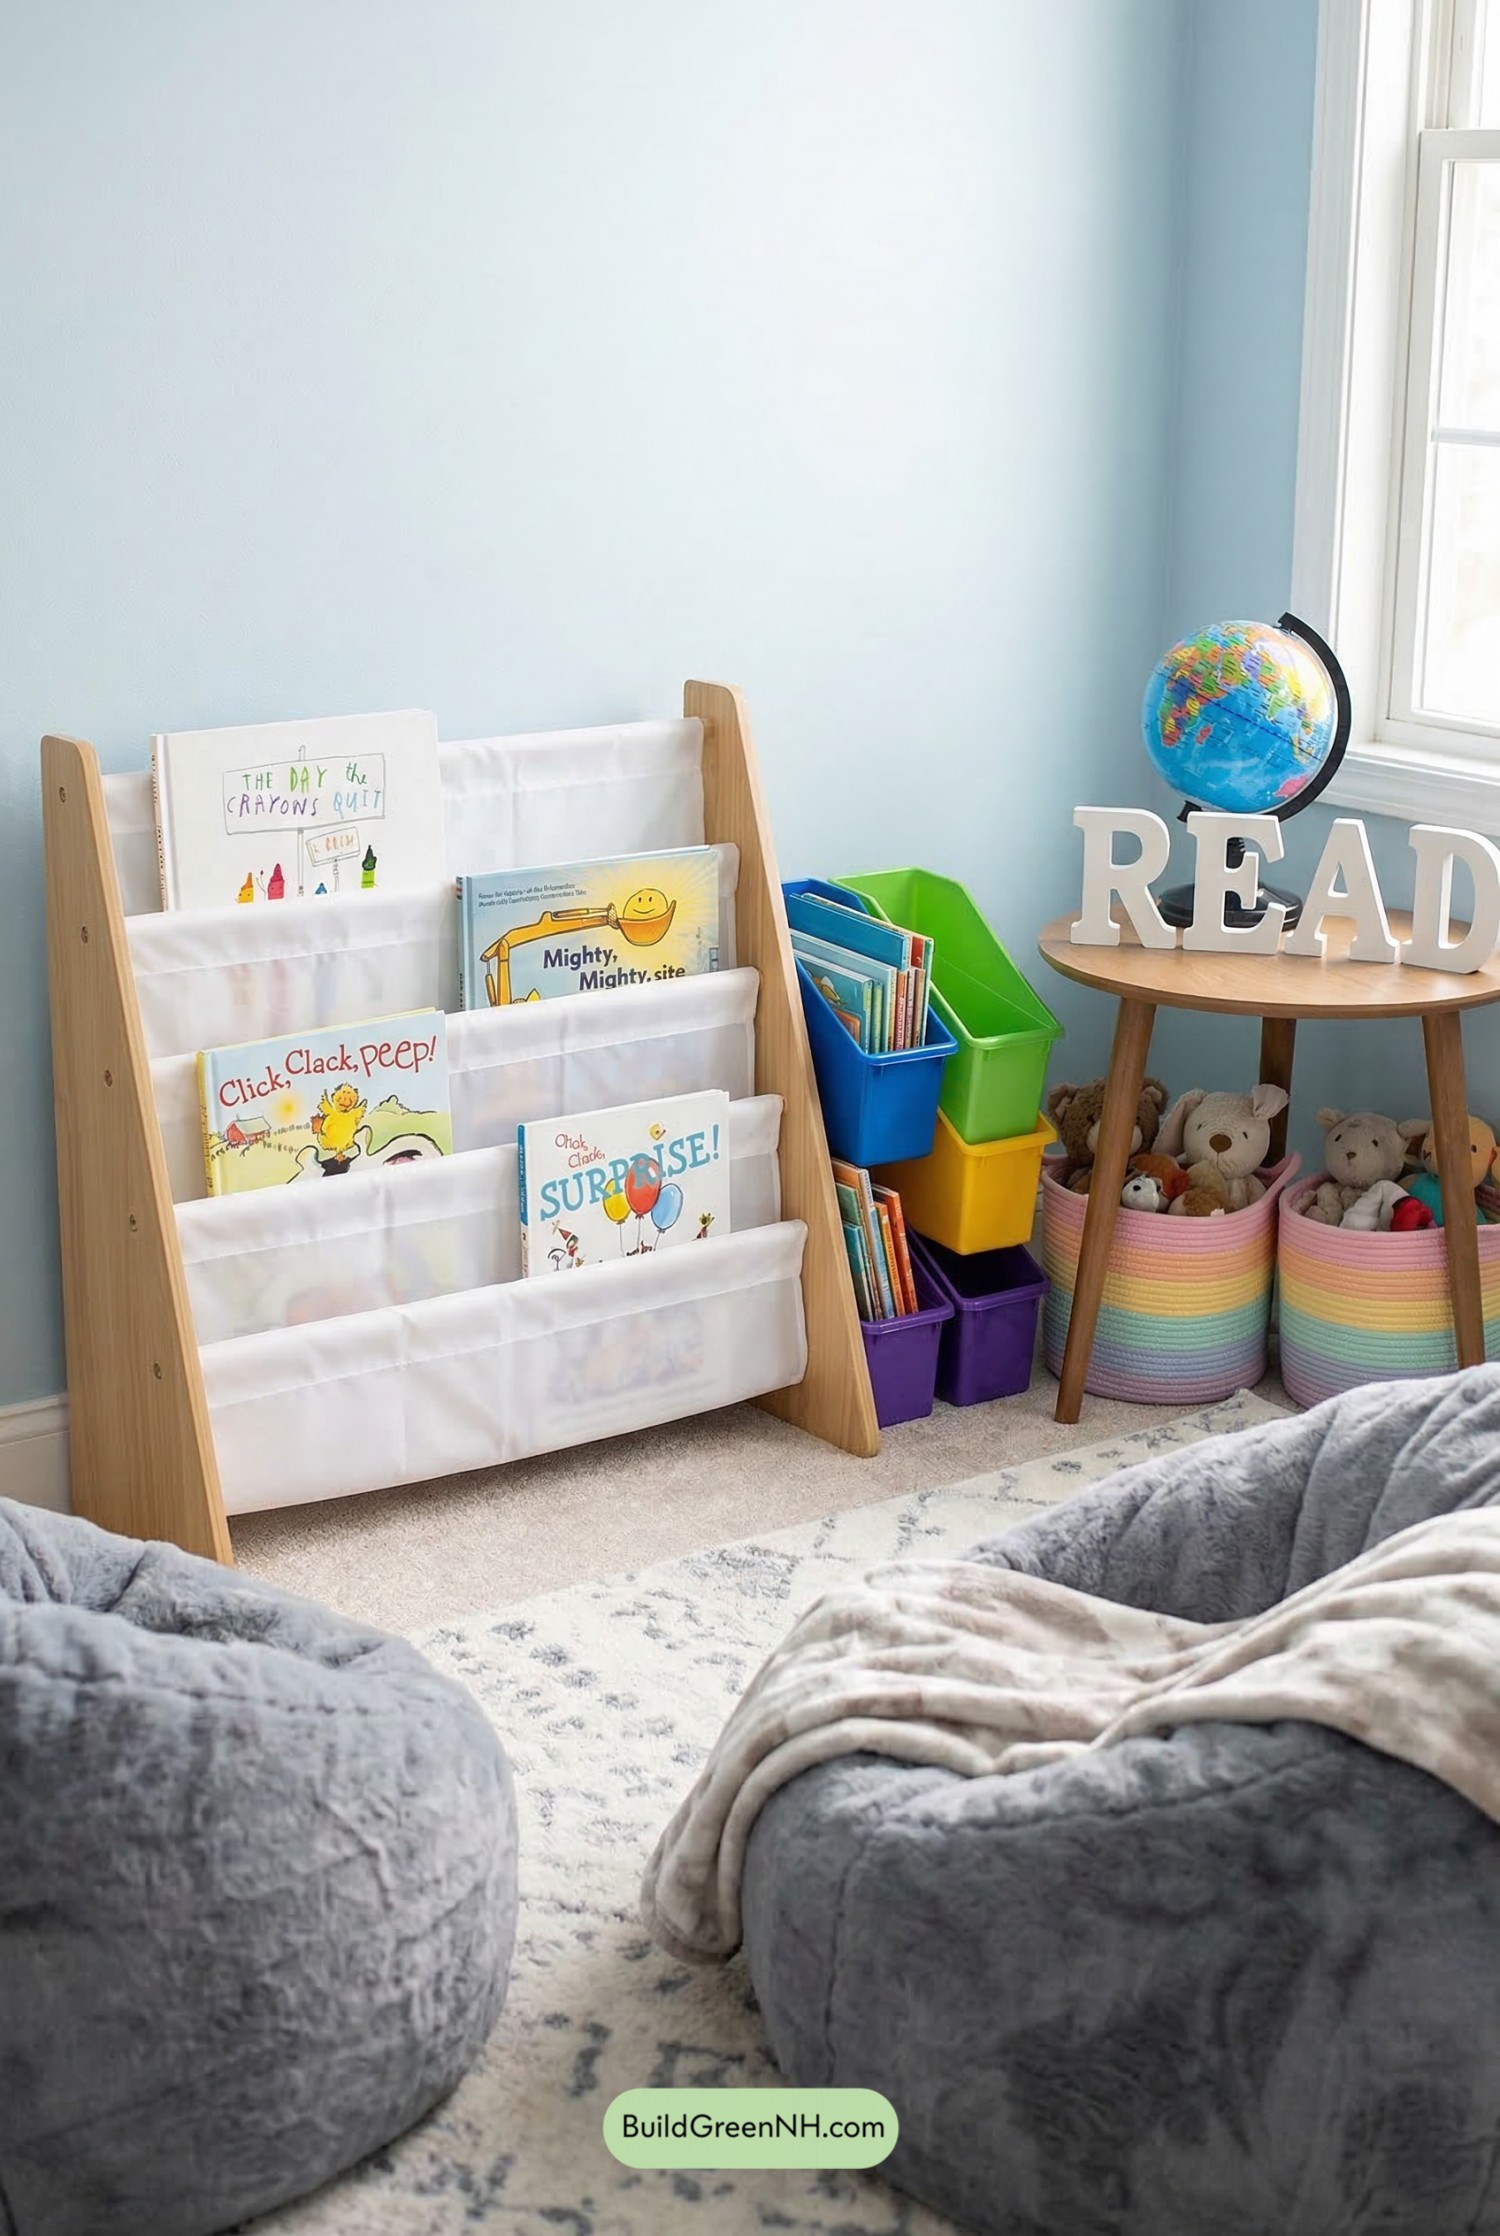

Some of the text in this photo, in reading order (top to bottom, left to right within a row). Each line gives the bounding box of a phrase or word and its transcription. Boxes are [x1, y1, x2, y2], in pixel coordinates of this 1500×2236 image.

[242, 761, 367, 793] THE DAY the
[227, 789, 382, 819] CRAYONS QUIT
[1069, 805, 1500, 974] READ
[543, 944, 618, 971] Mighty,
[219, 1066, 292, 1108] Click,
[285, 1043, 359, 1075] Clack,
[540, 1124, 720, 1222] SURPRISE!
